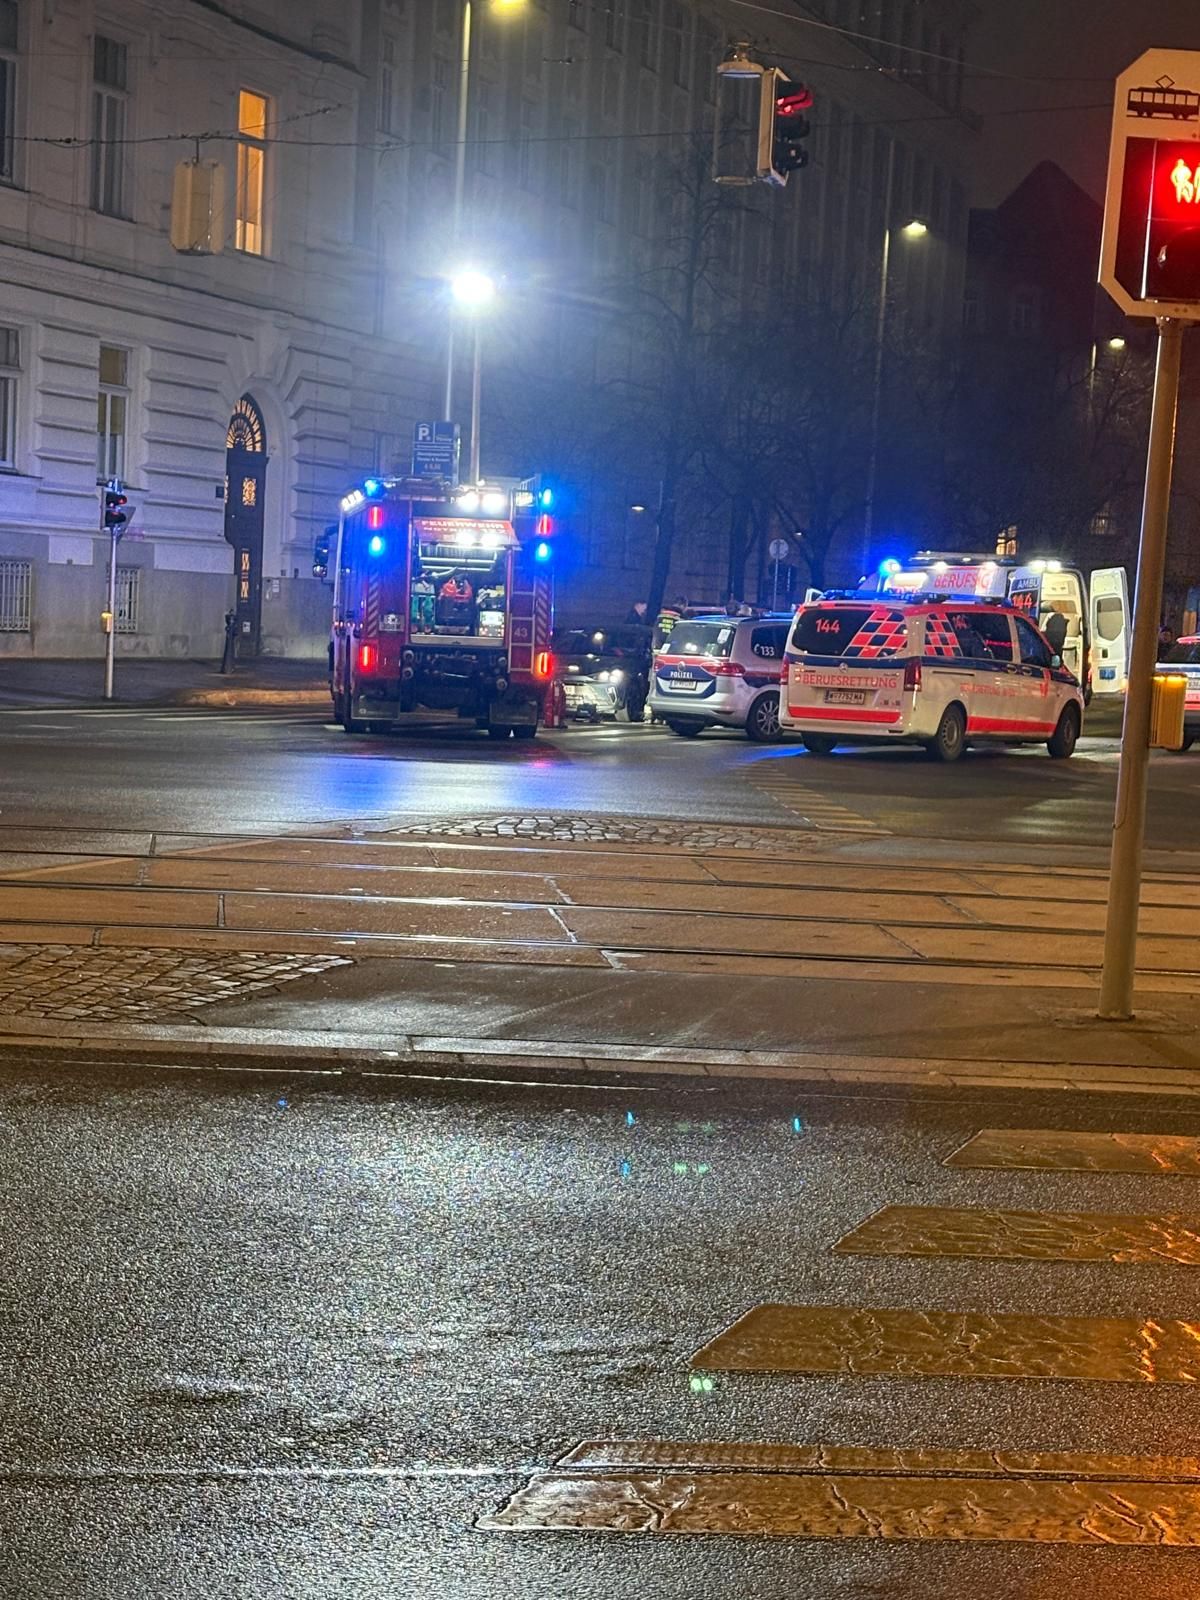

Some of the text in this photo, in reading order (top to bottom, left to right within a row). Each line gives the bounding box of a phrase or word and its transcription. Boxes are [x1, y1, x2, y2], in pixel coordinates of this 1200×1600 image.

[1012, 592, 1032, 609] 144
[815, 619, 840, 633] 144
[514, 627, 528, 638] 43
[760, 646, 775, 656] 133
[670, 671, 693, 679] POLIZEI
[802, 674, 897, 688] BERUFSRETTUNG
